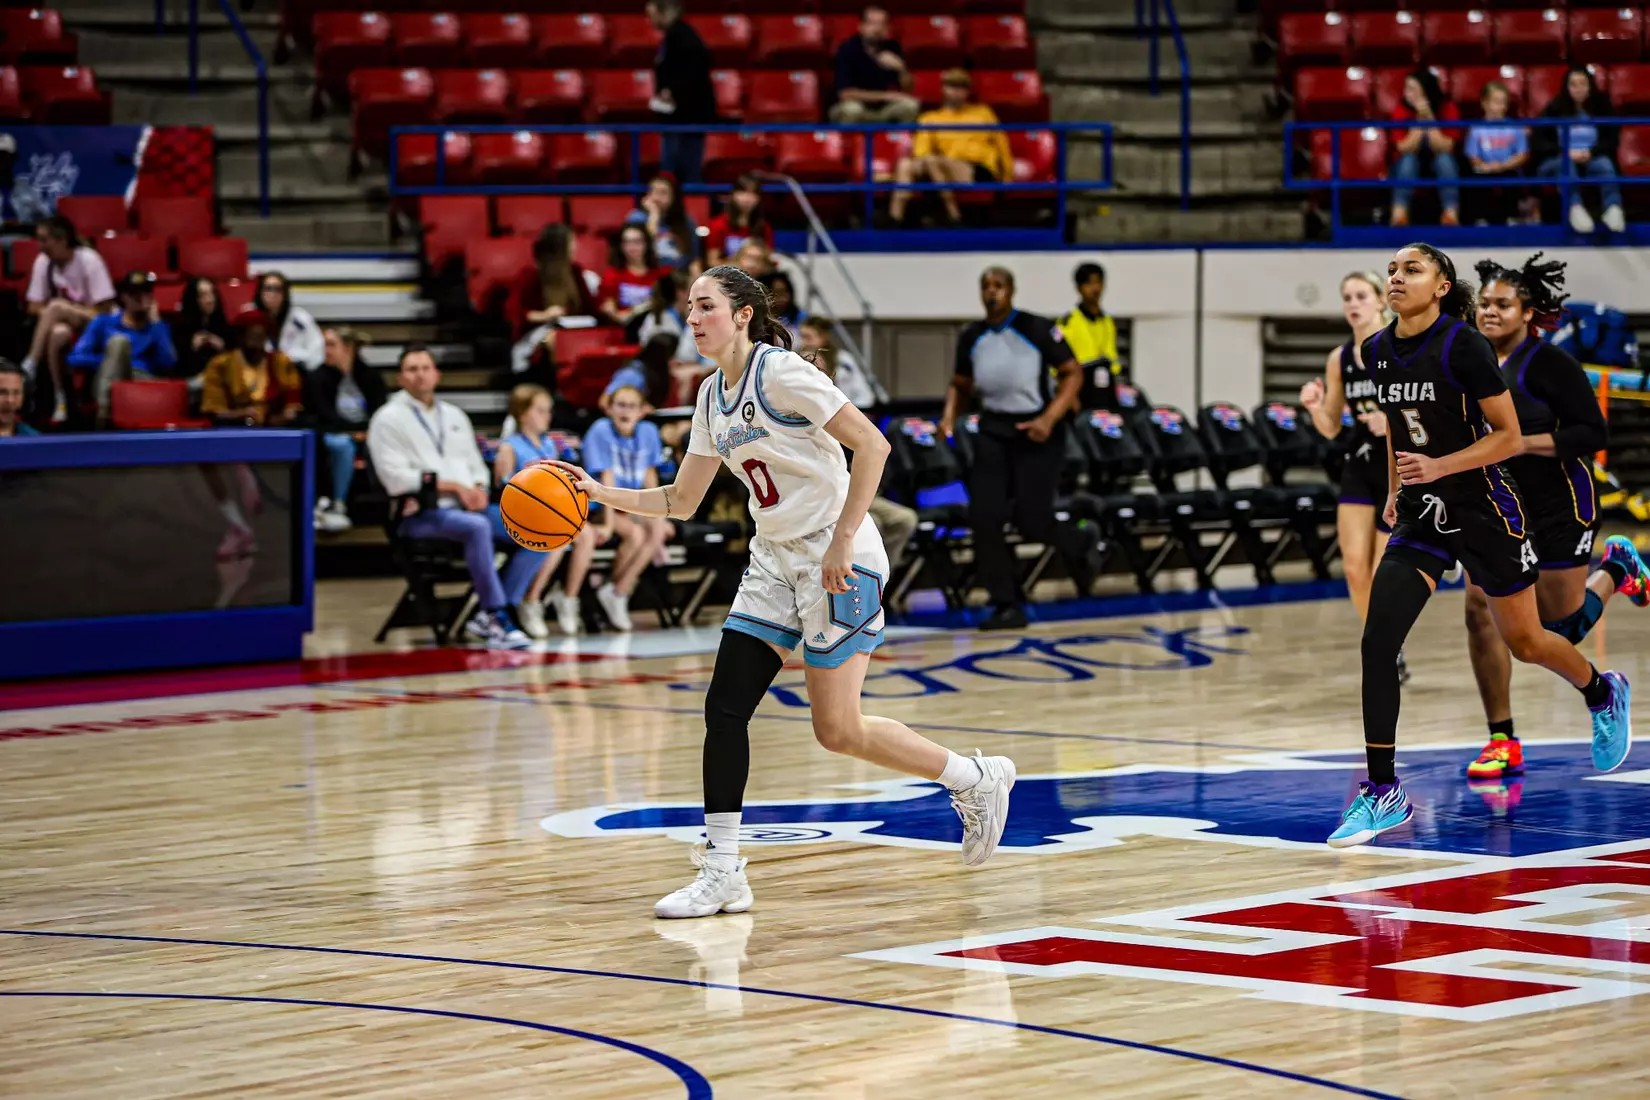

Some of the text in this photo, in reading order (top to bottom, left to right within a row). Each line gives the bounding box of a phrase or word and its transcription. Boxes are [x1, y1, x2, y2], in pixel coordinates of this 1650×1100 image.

[1377, 382, 1436, 404] LSUA
[1401, 408, 1429, 447] 5
[740, 458, 780, 508] 0
[1520, 538, 1539, 573] A
[1574, 529, 1593, 556] A
